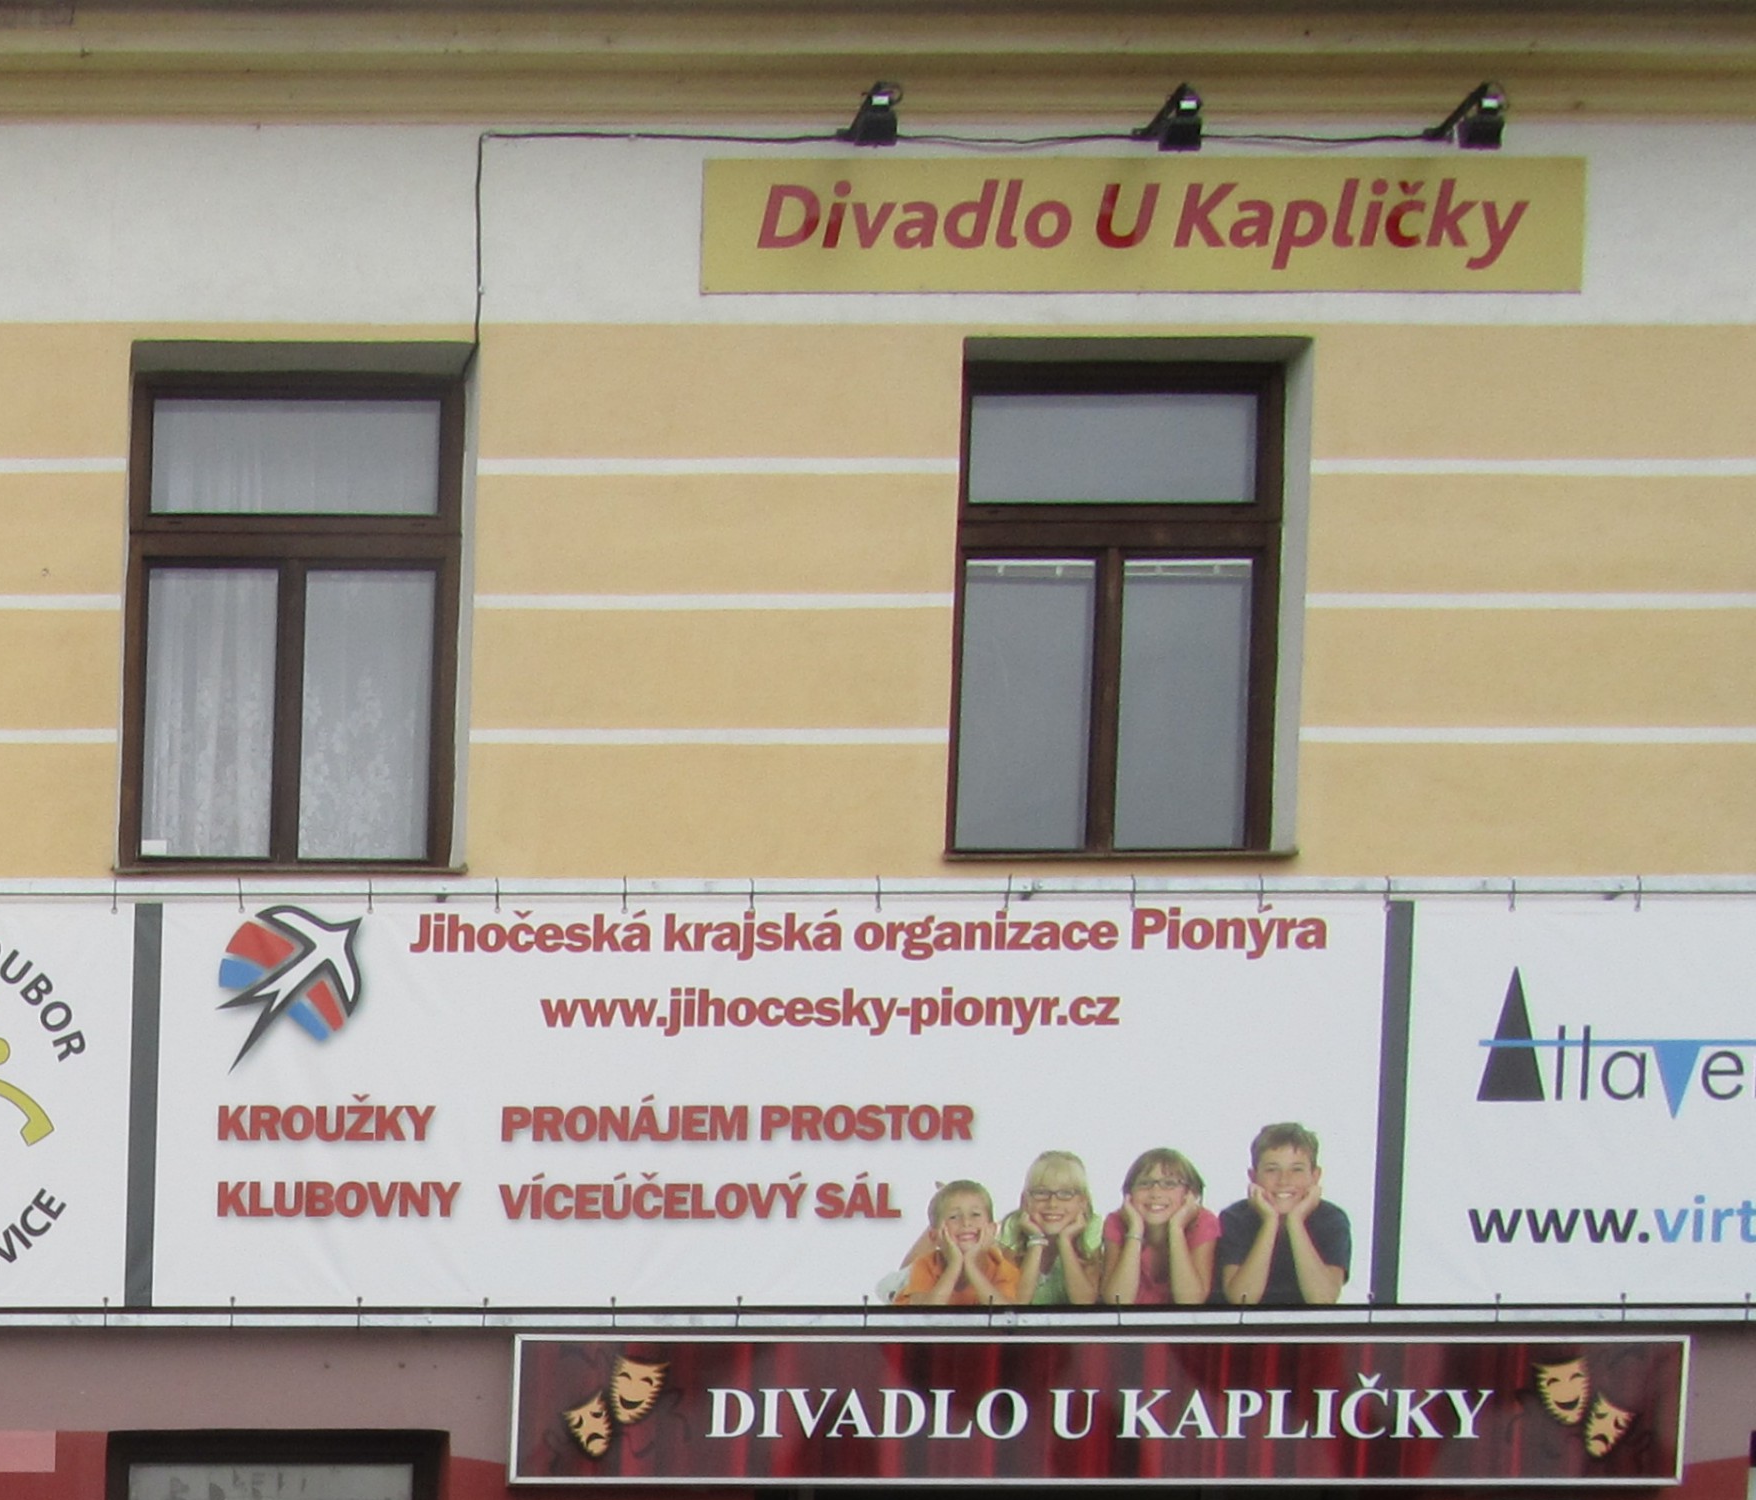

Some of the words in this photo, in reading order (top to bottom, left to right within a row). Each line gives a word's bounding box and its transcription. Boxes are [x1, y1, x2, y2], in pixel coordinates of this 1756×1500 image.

[756, 179, 1072, 250] Divadlo
[1094, 183, 1158, 250] U
[1173, 178, 1531, 271] Kapličky
[409, 909, 652, 954] Jihočeská
[663, 908, 842, 961] krajská
[852, 910, 1119, 961] organizace
[1130, 904, 1328, 960] Pionýra
[539, 987, 1121, 1037] www.jihocesky-pionyr.cz
[217, 1093, 436, 1143] KROUŽKY
[500, 1094, 748, 1143] PRONÁJEM
[760, 1104, 974, 1142] PROSTOR
[217, 1180, 461, 1219] KLUBOVNY
[498, 1172, 806, 1221] VÍCEÚČELOVÝ
[814, 1171, 901, 1220] SÁL
[705, 1387, 1029, 1440] DIVADLO
[1050, 1387, 1099, 1440] U
[1115, 1373, 1495, 1440] KAPLIČKY
